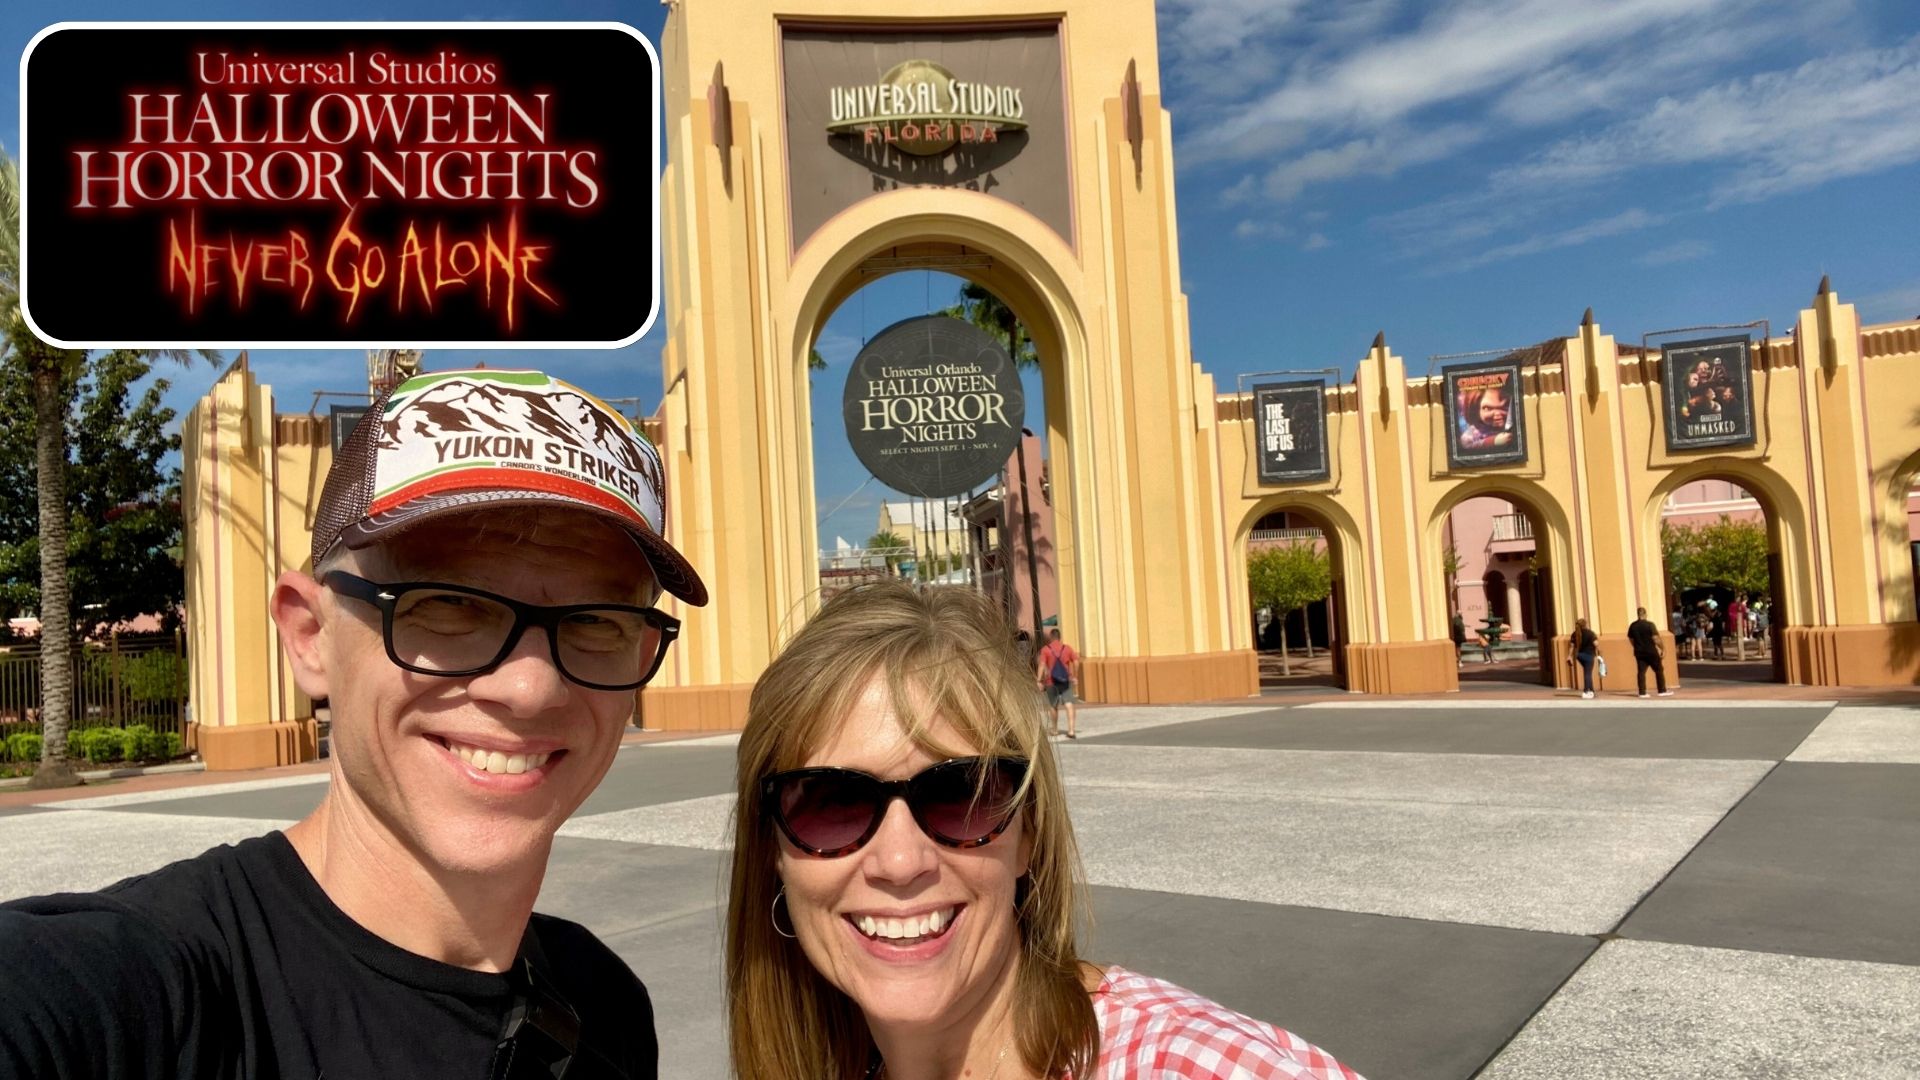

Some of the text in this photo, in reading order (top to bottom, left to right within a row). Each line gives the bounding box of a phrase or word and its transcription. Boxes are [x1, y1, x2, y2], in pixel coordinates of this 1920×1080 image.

[831, 79, 1023, 121] UNIVERSAL STUDIOS
[865, 125, 997, 143] FLORIDA
[882, 363, 981, 378] Universal Orlando
[869, 375, 996, 397] HALLOWEEN
[860, 394, 1012, 430] HORROR
[1265, 403, 1284, 419] THE
[902, 423, 976, 442] NIGHTS
[1265, 418, 1290, 435] LAST
[1688, 421, 1735, 436] UNMASKED
[1266, 434, 1294, 451] OF US
[434, 436, 640, 504] YUKON STRIKER
[501, 460, 597, 486] CANADA'S WONDERLAND
